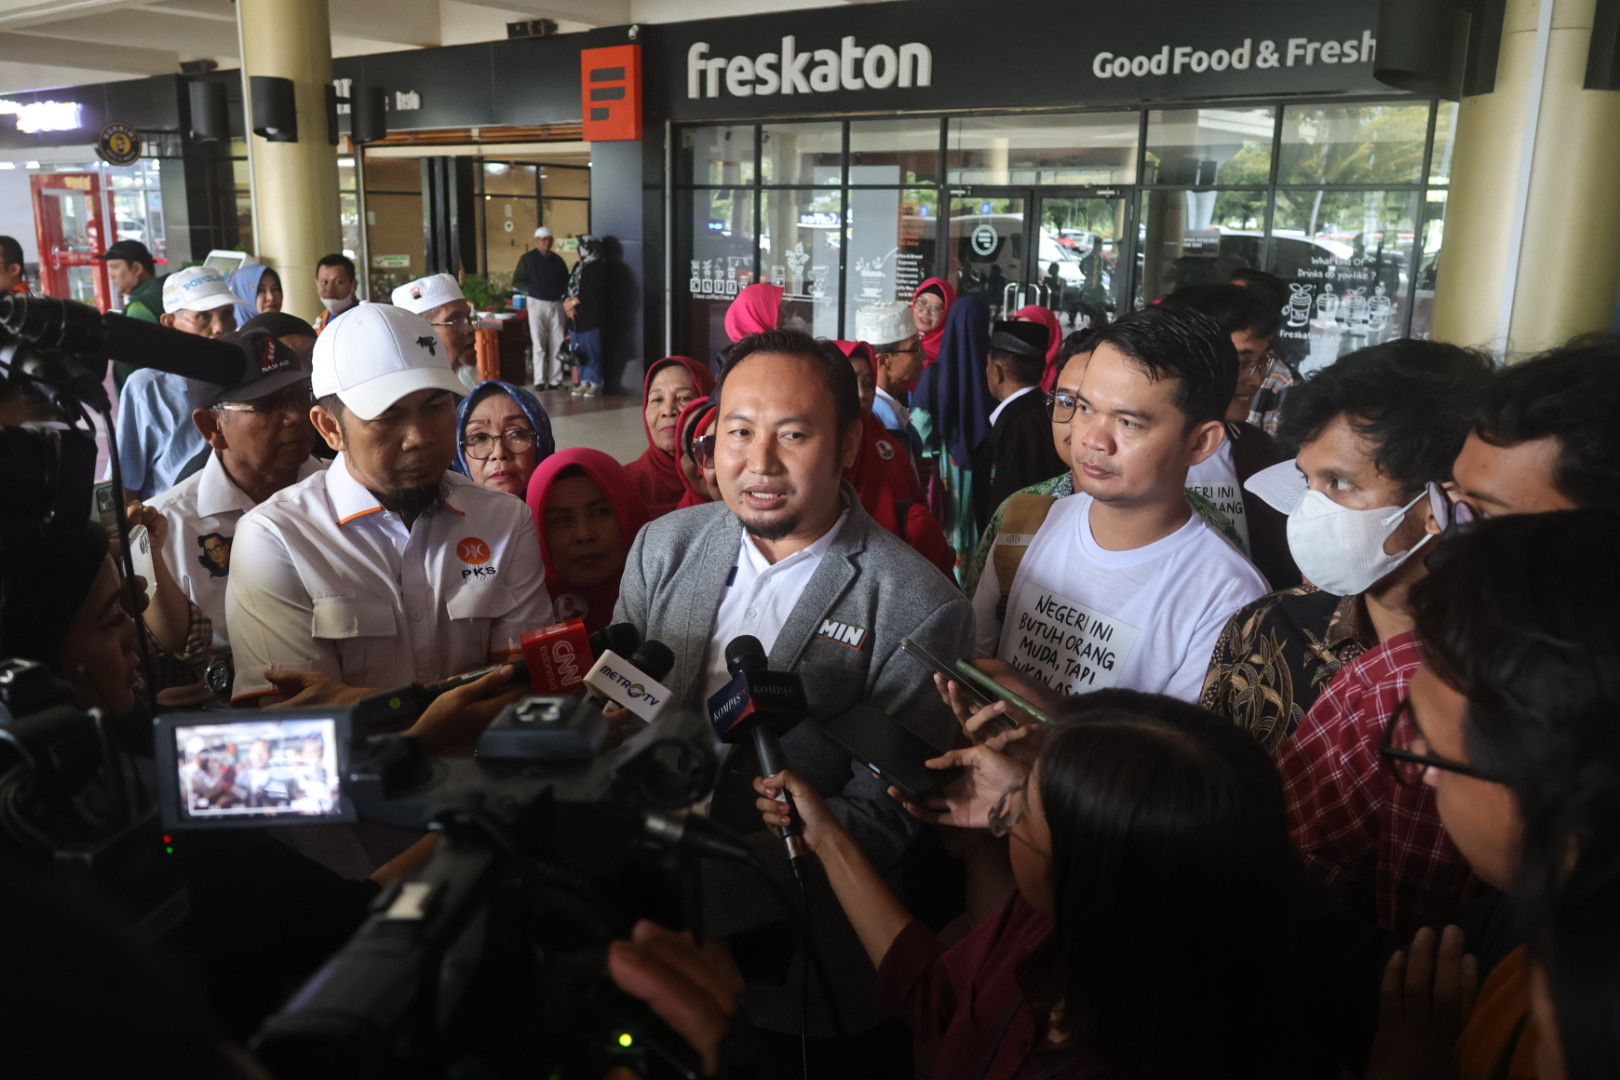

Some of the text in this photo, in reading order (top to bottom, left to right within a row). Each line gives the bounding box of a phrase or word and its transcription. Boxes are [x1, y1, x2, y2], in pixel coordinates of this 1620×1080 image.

[687, 34, 933, 99] freskaton
[1092, 45, 1169, 78] Good
[1173, 38, 1252, 75] Food
[1255, 39, 1281, 69] &
[261, 363, 279, 373] NAM
[1217, 486, 1234, 498] INI
[461, 566, 496, 579] PKS
[1019, 612, 1116, 672] BUTUH ORANG
[1035, 595, 1114, 643] NEGERI INI
[539, 645, 558, 691] Indonesia
[552, 640, 583, 687] CNN
[1019, 635, 1096, 686] MUDA, TAPI
[713, 692, 741, 722] KOMPAS
